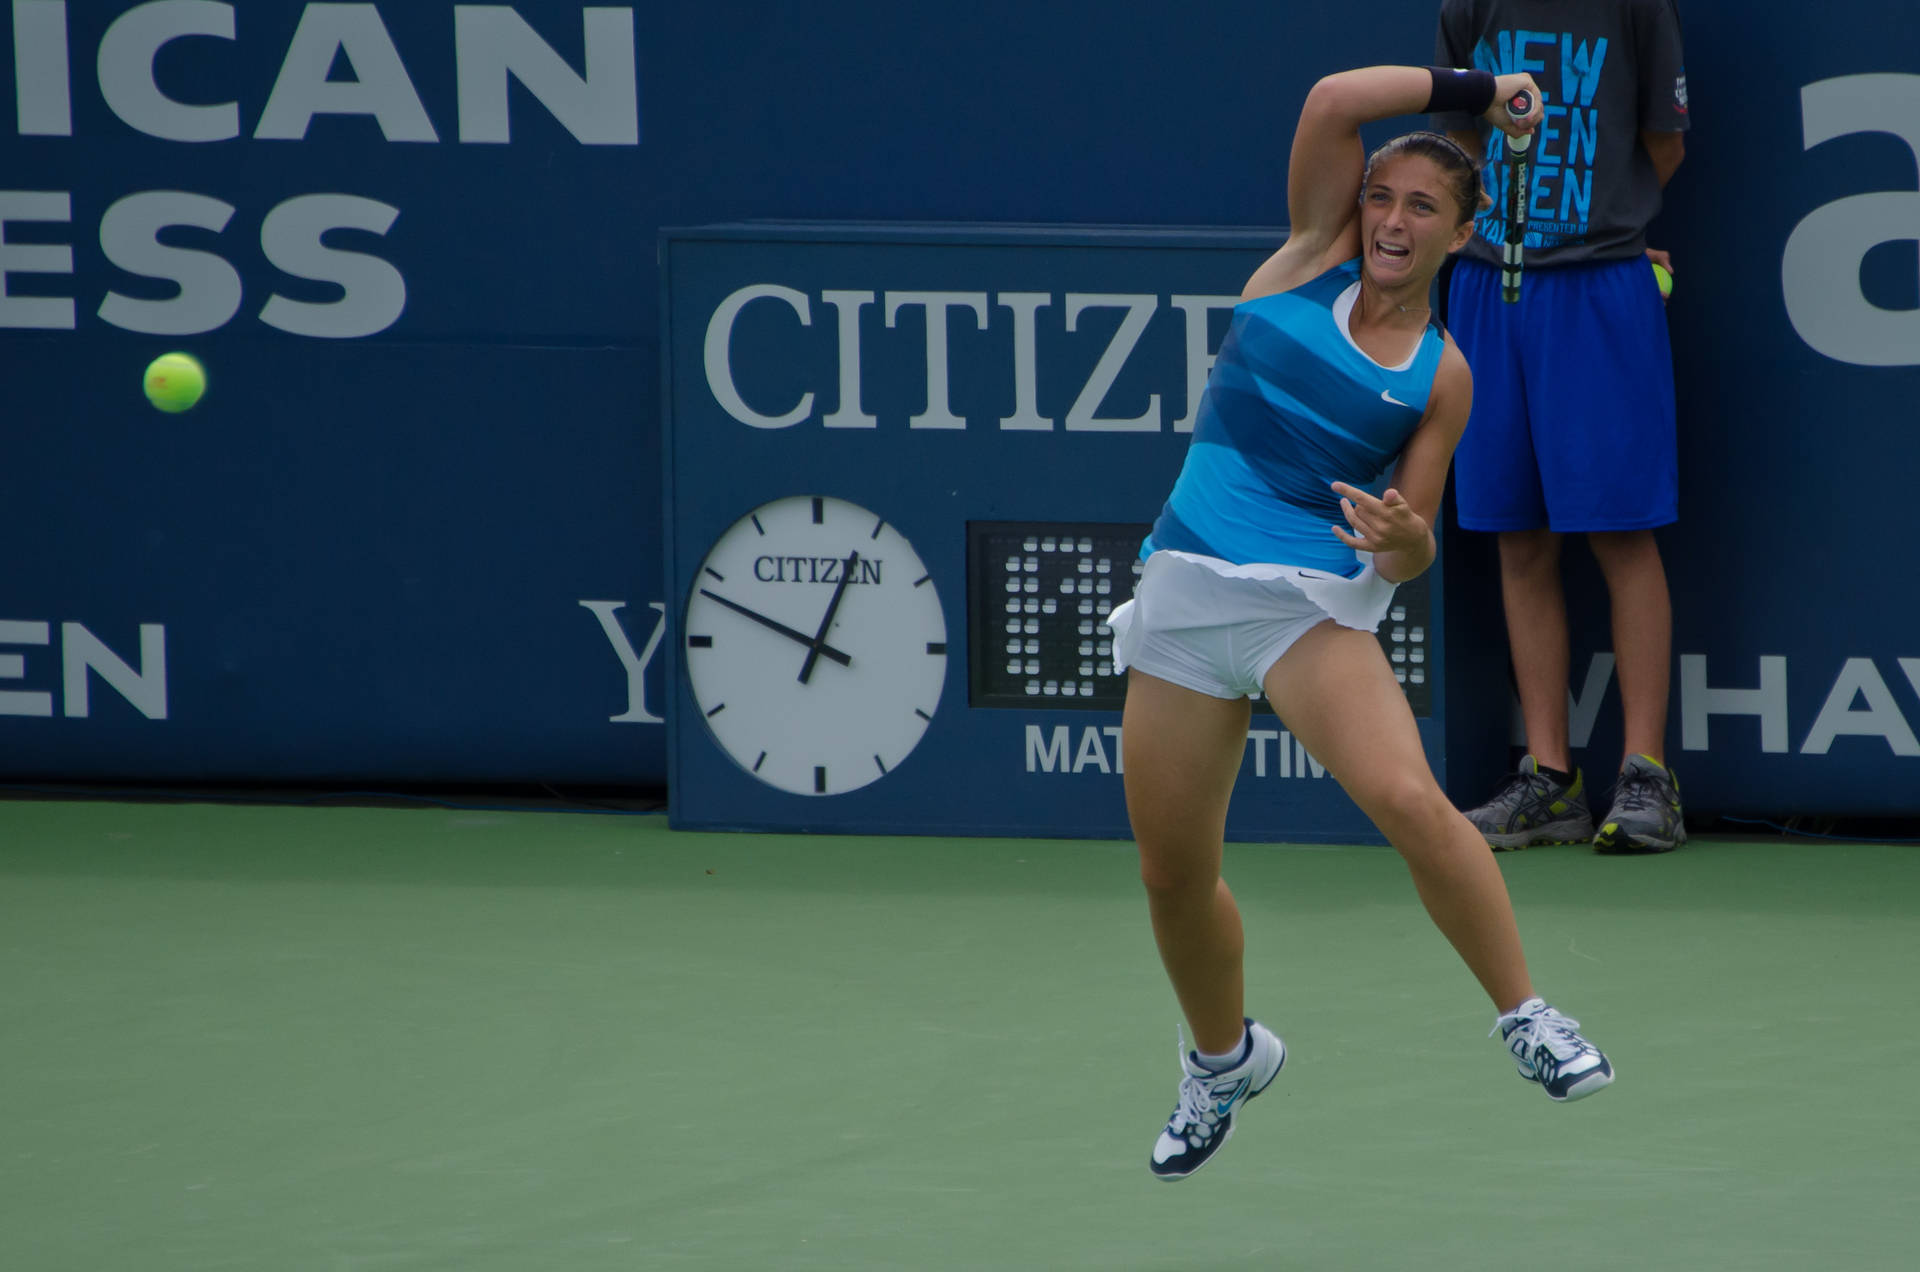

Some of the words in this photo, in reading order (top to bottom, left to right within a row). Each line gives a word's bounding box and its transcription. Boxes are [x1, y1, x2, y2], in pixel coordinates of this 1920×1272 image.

[13, 0, 639, 145] ICAN
[0, 190, 406, 338] ESS
[753, 555, 883, 585] CITIZEN
[1680, 653, 1920, 757] HA
